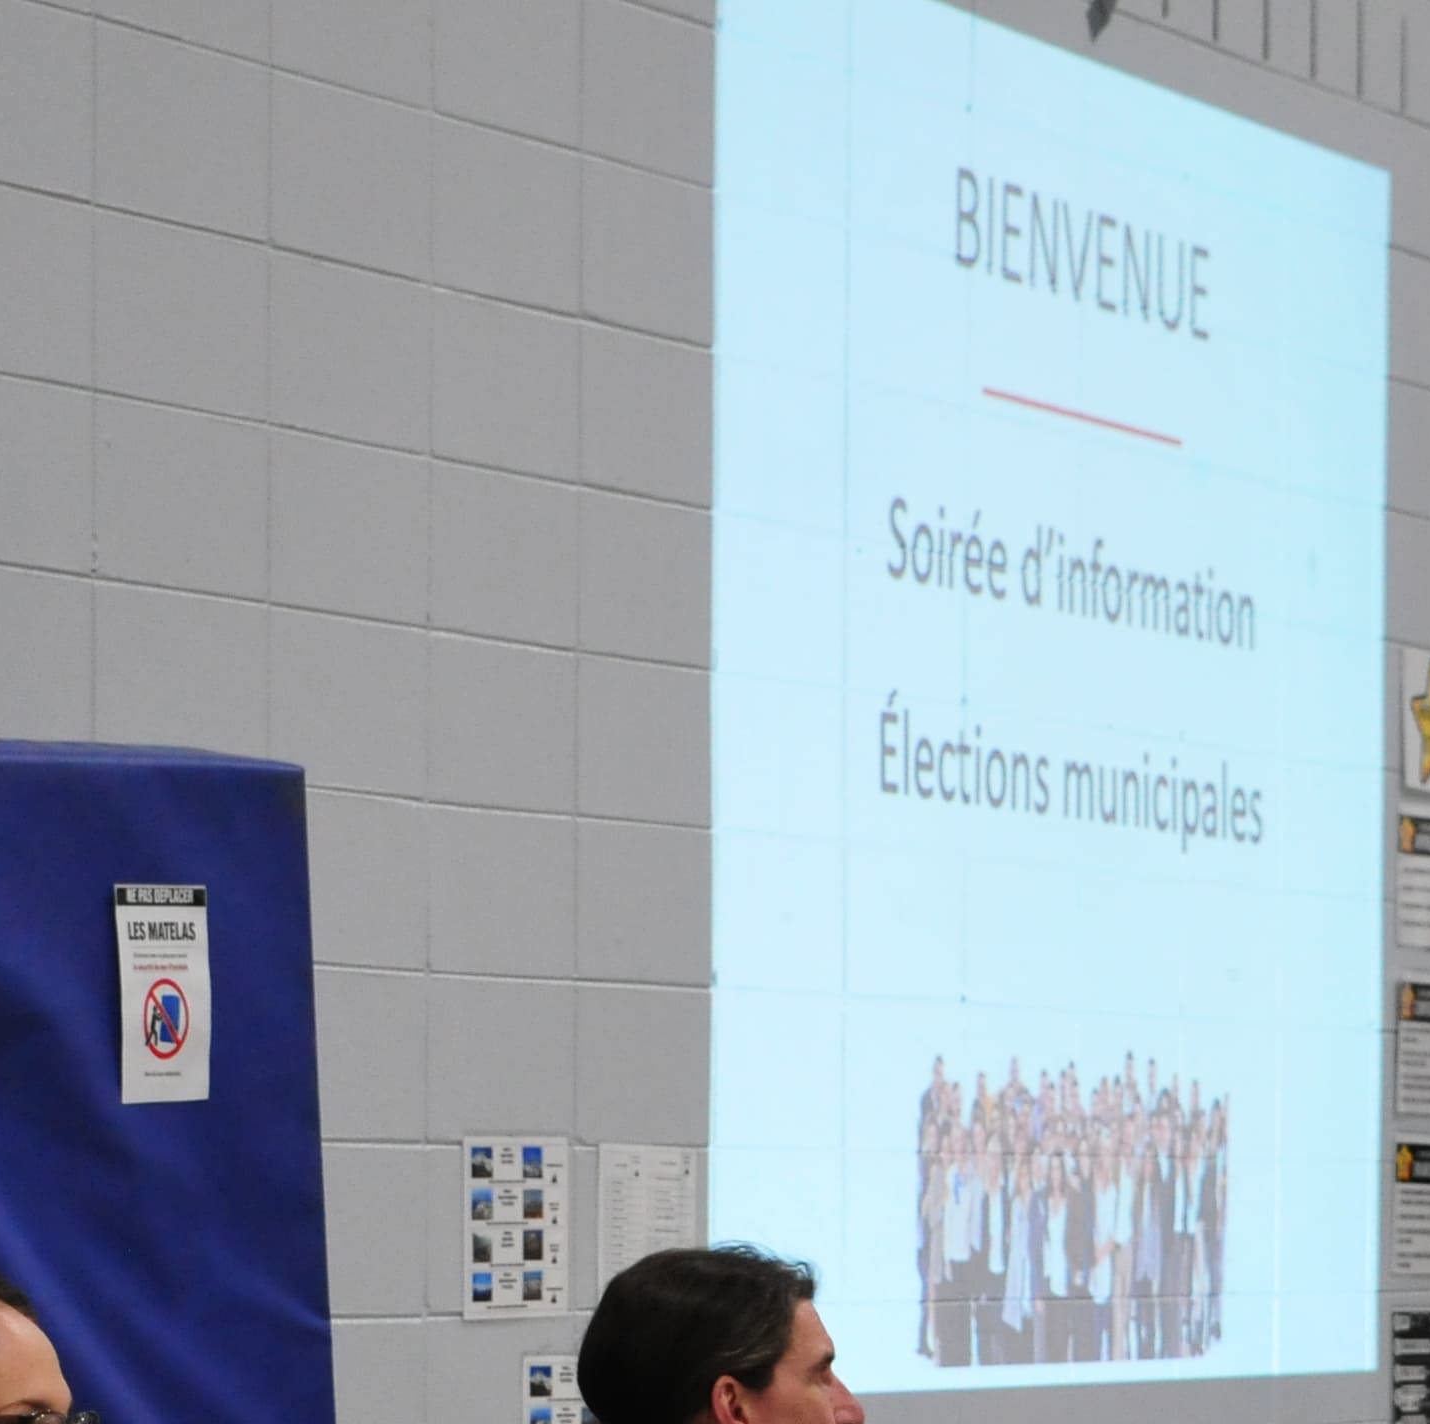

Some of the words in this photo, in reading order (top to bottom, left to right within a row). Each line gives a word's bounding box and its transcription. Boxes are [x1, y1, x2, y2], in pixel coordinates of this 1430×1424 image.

[954, 166, 1210, 341] BIENVENUE
[887, 496, 1009, 600] Soirée
[879, 689, 1050, 816] Élections
[1061, 750, 1264, 855] municipales
[127, 921, 146, 941] LES
[148, 921, 196, 941] MATELAS
